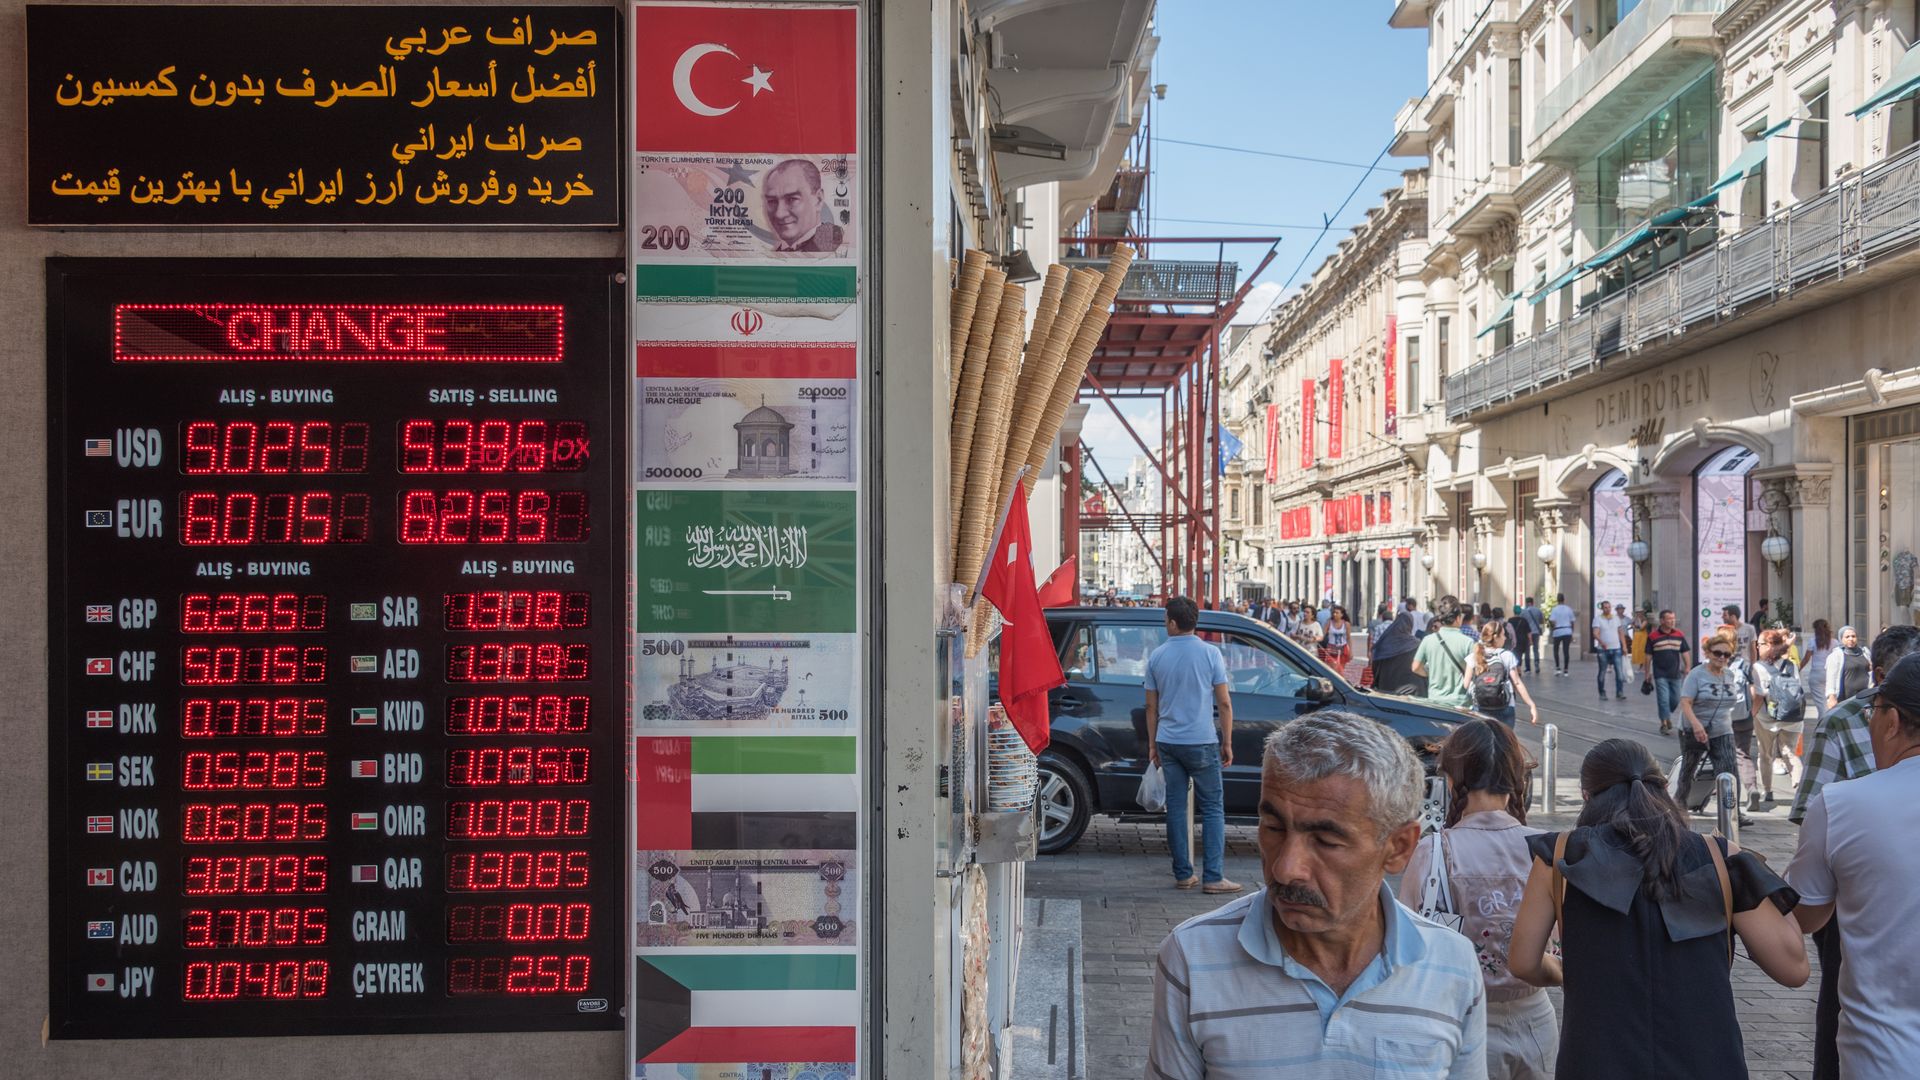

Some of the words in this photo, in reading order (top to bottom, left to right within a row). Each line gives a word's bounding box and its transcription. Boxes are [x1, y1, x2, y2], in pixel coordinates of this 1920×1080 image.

[385, 25, 473, 61] عربي
[486, 16, 598, 56] صراف
[55, 66, 179, 107] كمسيون
[189, 74, 265, 108] بدون
[275, 64, 397, 108] الصرف
[410, 60, 498, 108] أسعار
[510, 60, 598, 104] أفضل
[484, 124, 583, 161] صراف
[229, 168, 253, 203] با
[355, 169, 404, 206] ارز
[713, 187, 745, 204] 200
[641, 225, 690, 250] 200
[228, 311, 446, 351] CHANGE
[219, 389, 256, 407] ALIŞ
[270, 389, 334, 403] BUYING
[429, 388, 475, 407] SATIŞ
[488, 388, 558, 403] SELLING
[645, 397, 665, 405] IRAN
[667, 397, 702, 405] CHEQUE
[1595, 365, 1710, 428] DEMİRÖREN
[117, 428, 162, 467] USD
[645, 467, 702, 478] 500000
[117, 499, 162, 537] EUR
[196, 562, 233, 580] ALIŞ
[247, 561, 311, 576] BUYING
[461, 560, 498, 578] ALIŞ
[512, 559, 575, 574] BUYING
[118, 599, 157, 628] GBP
[382, 597, 419, 627] SAR
[642, 639, 685, 656] 500
[119, 651, 156, 681] CHF
[383, 649, 420, 679] AED
[119, 704, 157, 733] DKK
[383, 701, 424, 730] KWD
[819, 709, 849, 721] 500
[119, 756, 155, 786] SEK
[384, 753, 423, 783] BHD
[120, 809, 159, 839] NOK
[383, 806, 426, 836] OMR
[120, 862, 157, 892] CAD
[383, 858, 423, 889] QAR
[653, 866, 674, 875] 500
[825, 867, 842, 875] 500
[120, 915, 158, 944] AUD
[352, 911, 406, 941] GRAM
[817, 922, 838, 931] 500
[120, 967, 154, 997] JPY
